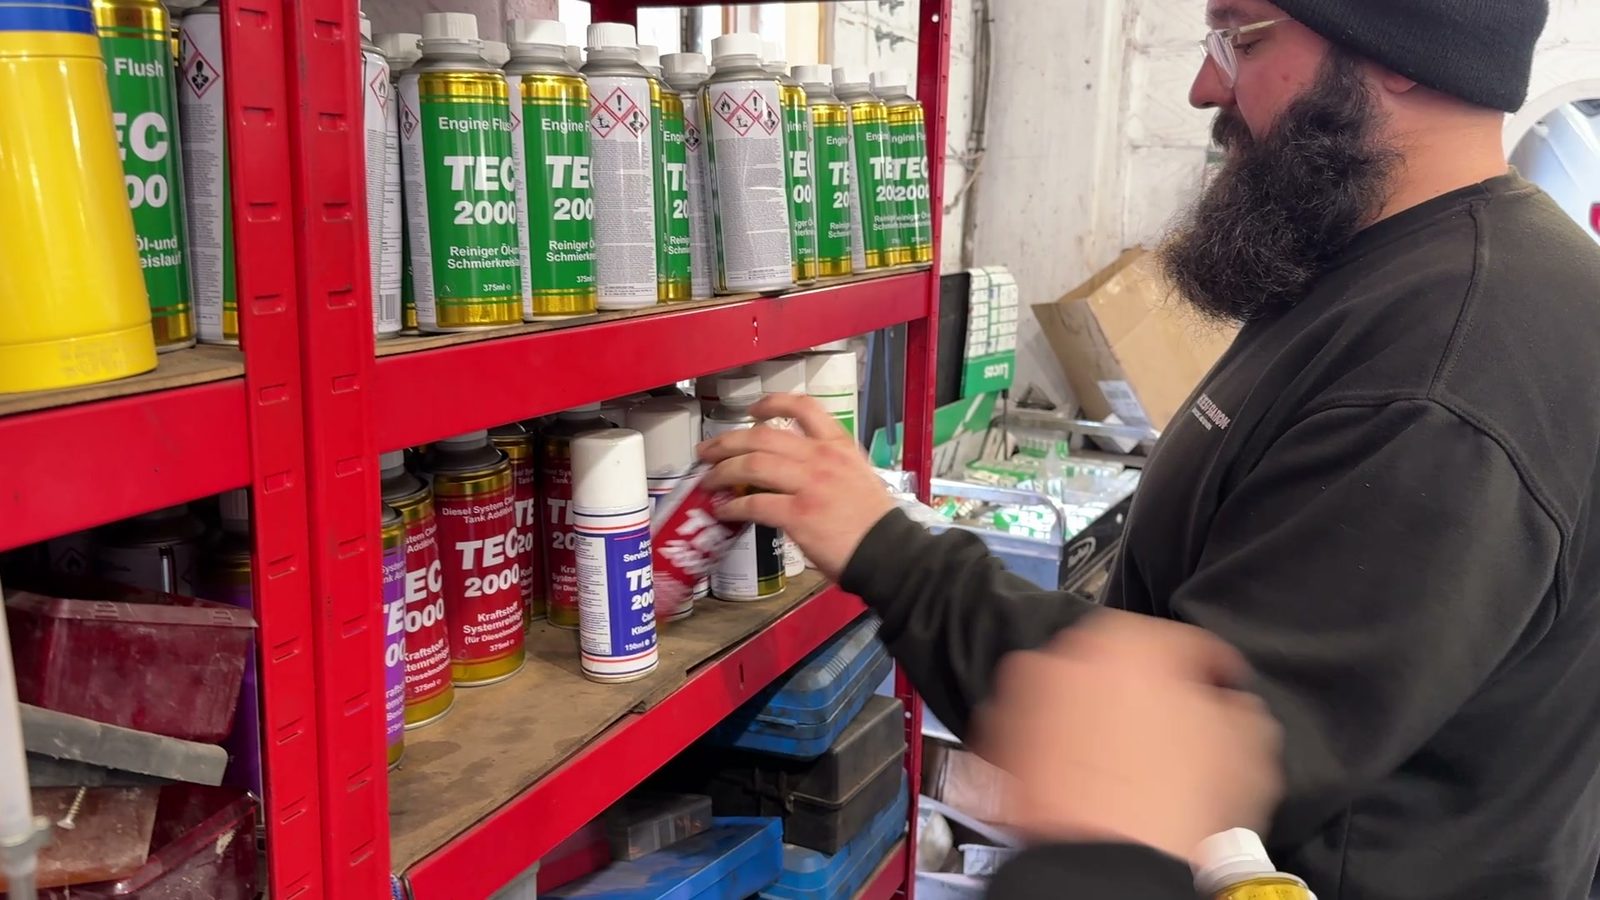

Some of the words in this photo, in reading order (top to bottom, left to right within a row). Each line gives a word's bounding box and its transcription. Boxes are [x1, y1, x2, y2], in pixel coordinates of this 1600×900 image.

[114, 57, 165, 78] Flush
[438, 116, 489, 133] Engine
[541, 117, 584, 133] Engine
[113, 112, 168, 162] EC
[891, 134, 915, 144] ngine
[443, 156, 514, 192] TEC
[125, 174, 168, 209] 00
[793, 185, 812, 203] 00
[833, 192, 849, 208] 20
[453, 200, 517, 225] 2000
[553, 198, 594, 221] 200
[450, 245, 498, 258] Reiniger
[549, 240, 588, 251] Reiniger
[140, 250, 182, 269] eislauf
[442, 508, 471, 516] Diesel
[473, 501, 503, 516] System
[464, 514, 486, 524] Tank
[455, 526, 518, 571] TEC
[518, 532, 533, 553] 20
[552, 531, 576, 551] 20
[560, 565, 576, 574] Kra
[626, 565, 652, 591] TE
[405, 560, 442, 604] EC
[464, 563, 519, 598] 2000
[631, 589, 654, 611] 200
[405, 598, 444, 633] 000
[477, 601, 518, 623] Kraftstoff
